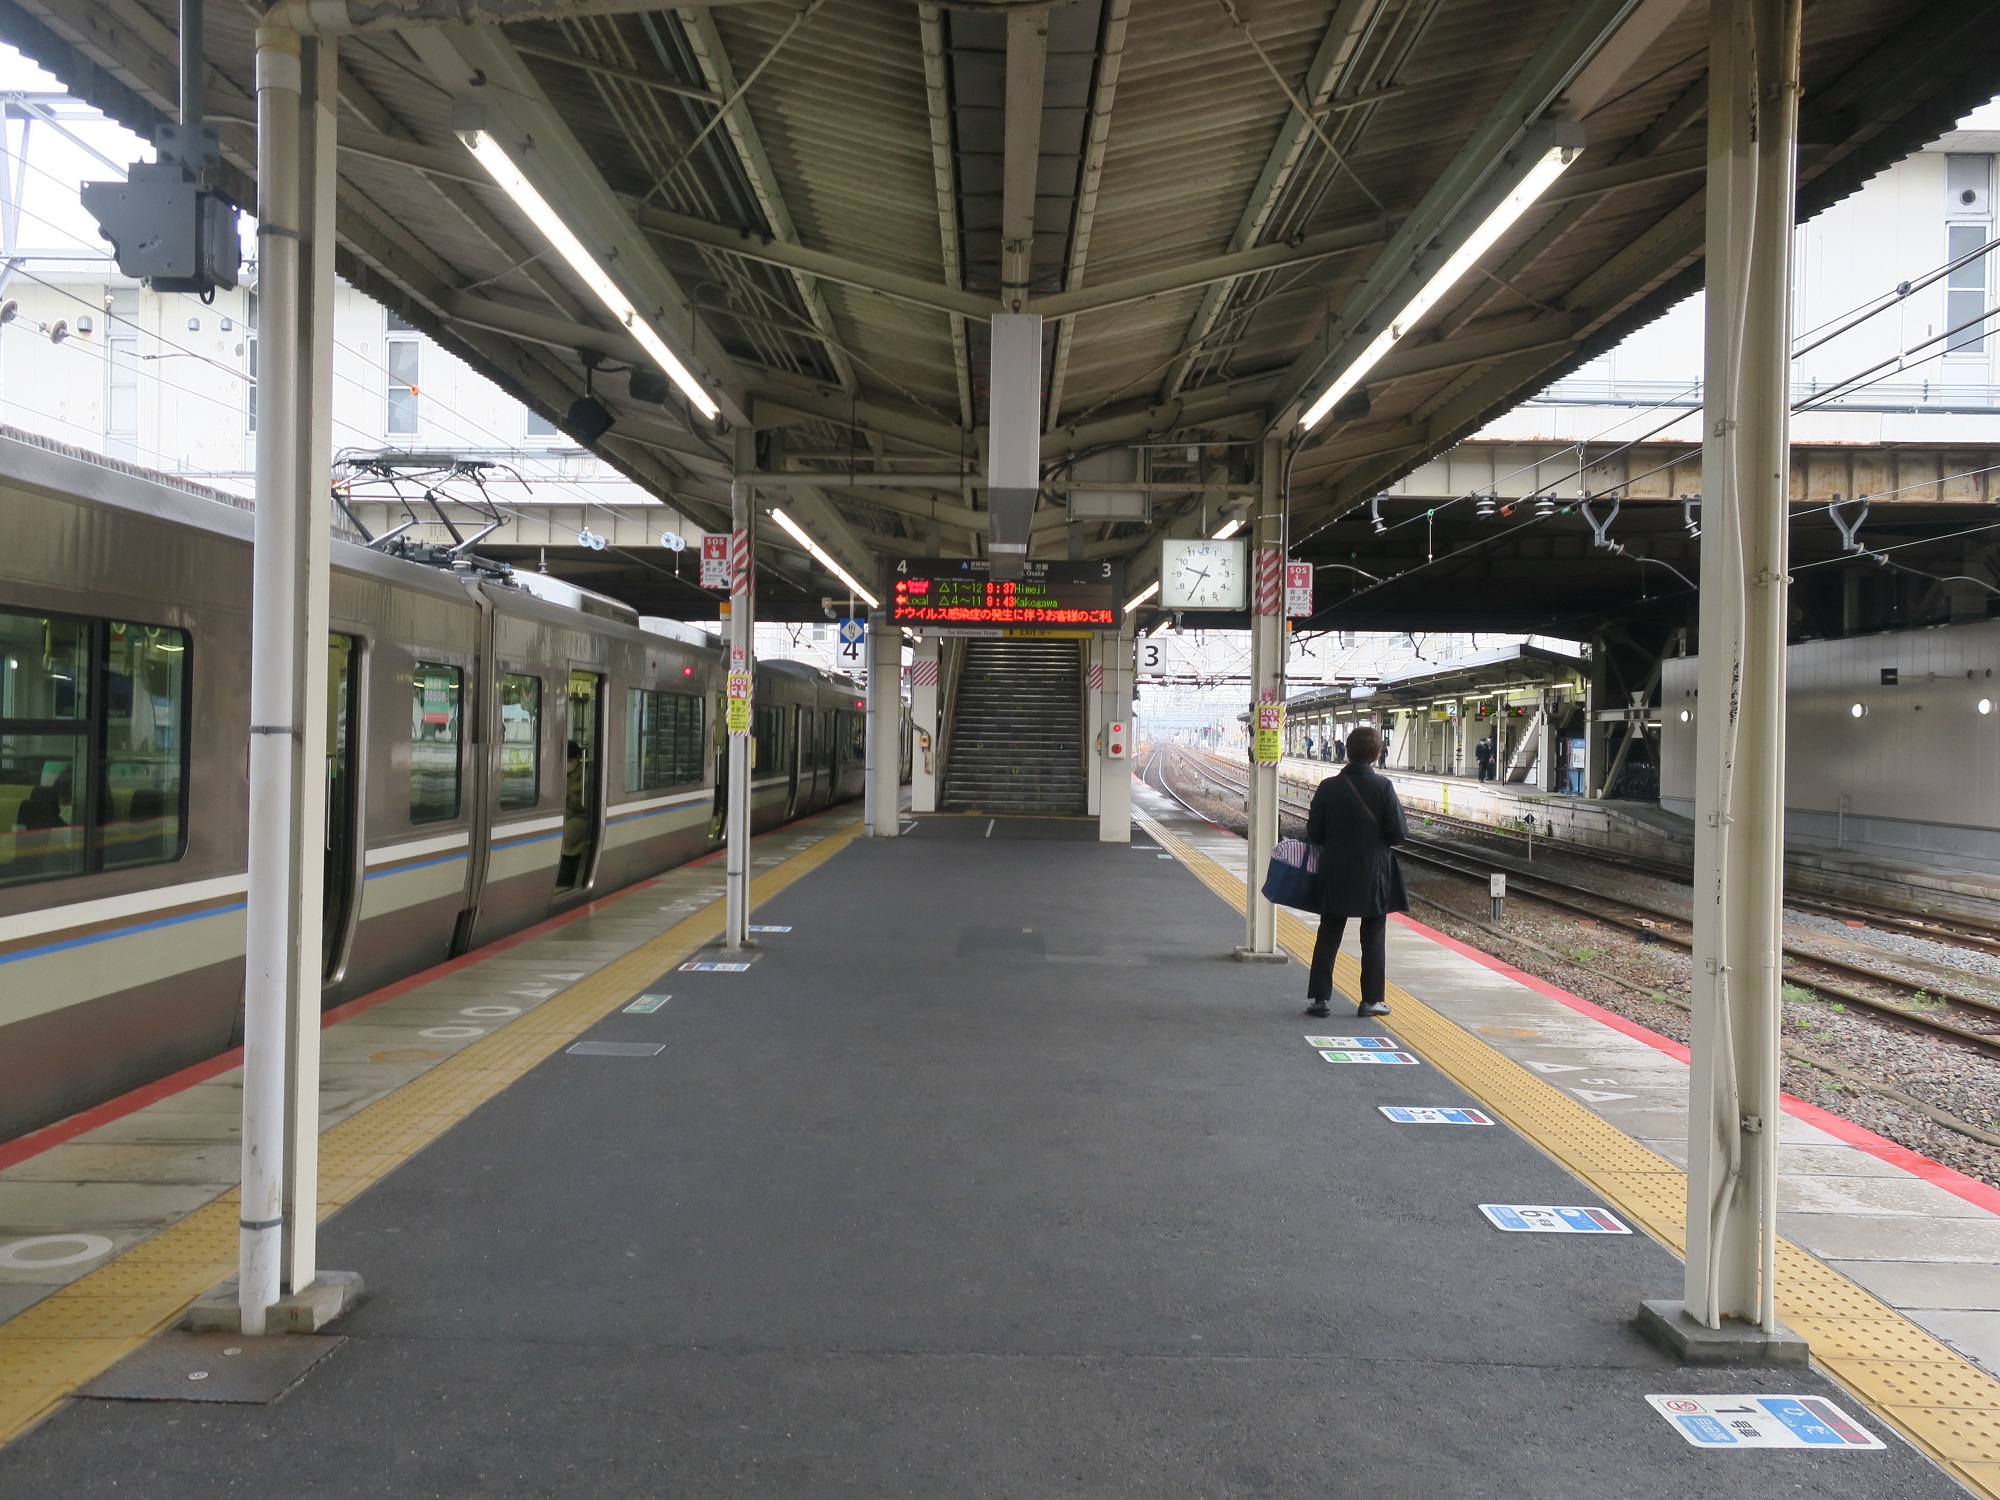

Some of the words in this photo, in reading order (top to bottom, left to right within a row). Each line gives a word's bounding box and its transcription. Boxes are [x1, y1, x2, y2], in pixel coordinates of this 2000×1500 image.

[897, 560, 908, 574] 4
[1102, 563, 1111, 577] 3
[986, 582, 1015, 595] 9:37
[1014, 583, 1046, 595] Himeji
[906, 595, 929, 605] Local
[986, 595, 1015, 607] 9:43
[1014, 596, 1058, 608] Kakogawa
[843, 642, 859, 660] 4
[1144, 645, 1159, 667] 3
[1449, 705, 1456, 716] 2
[1714, 1405, 1757, 1414] 1
[1730, 1419, 1762, 1438] 号車
[1783, 1407, 1830, 1436] ひだ
[1692, 1417, 1731, 1442] 自由席
